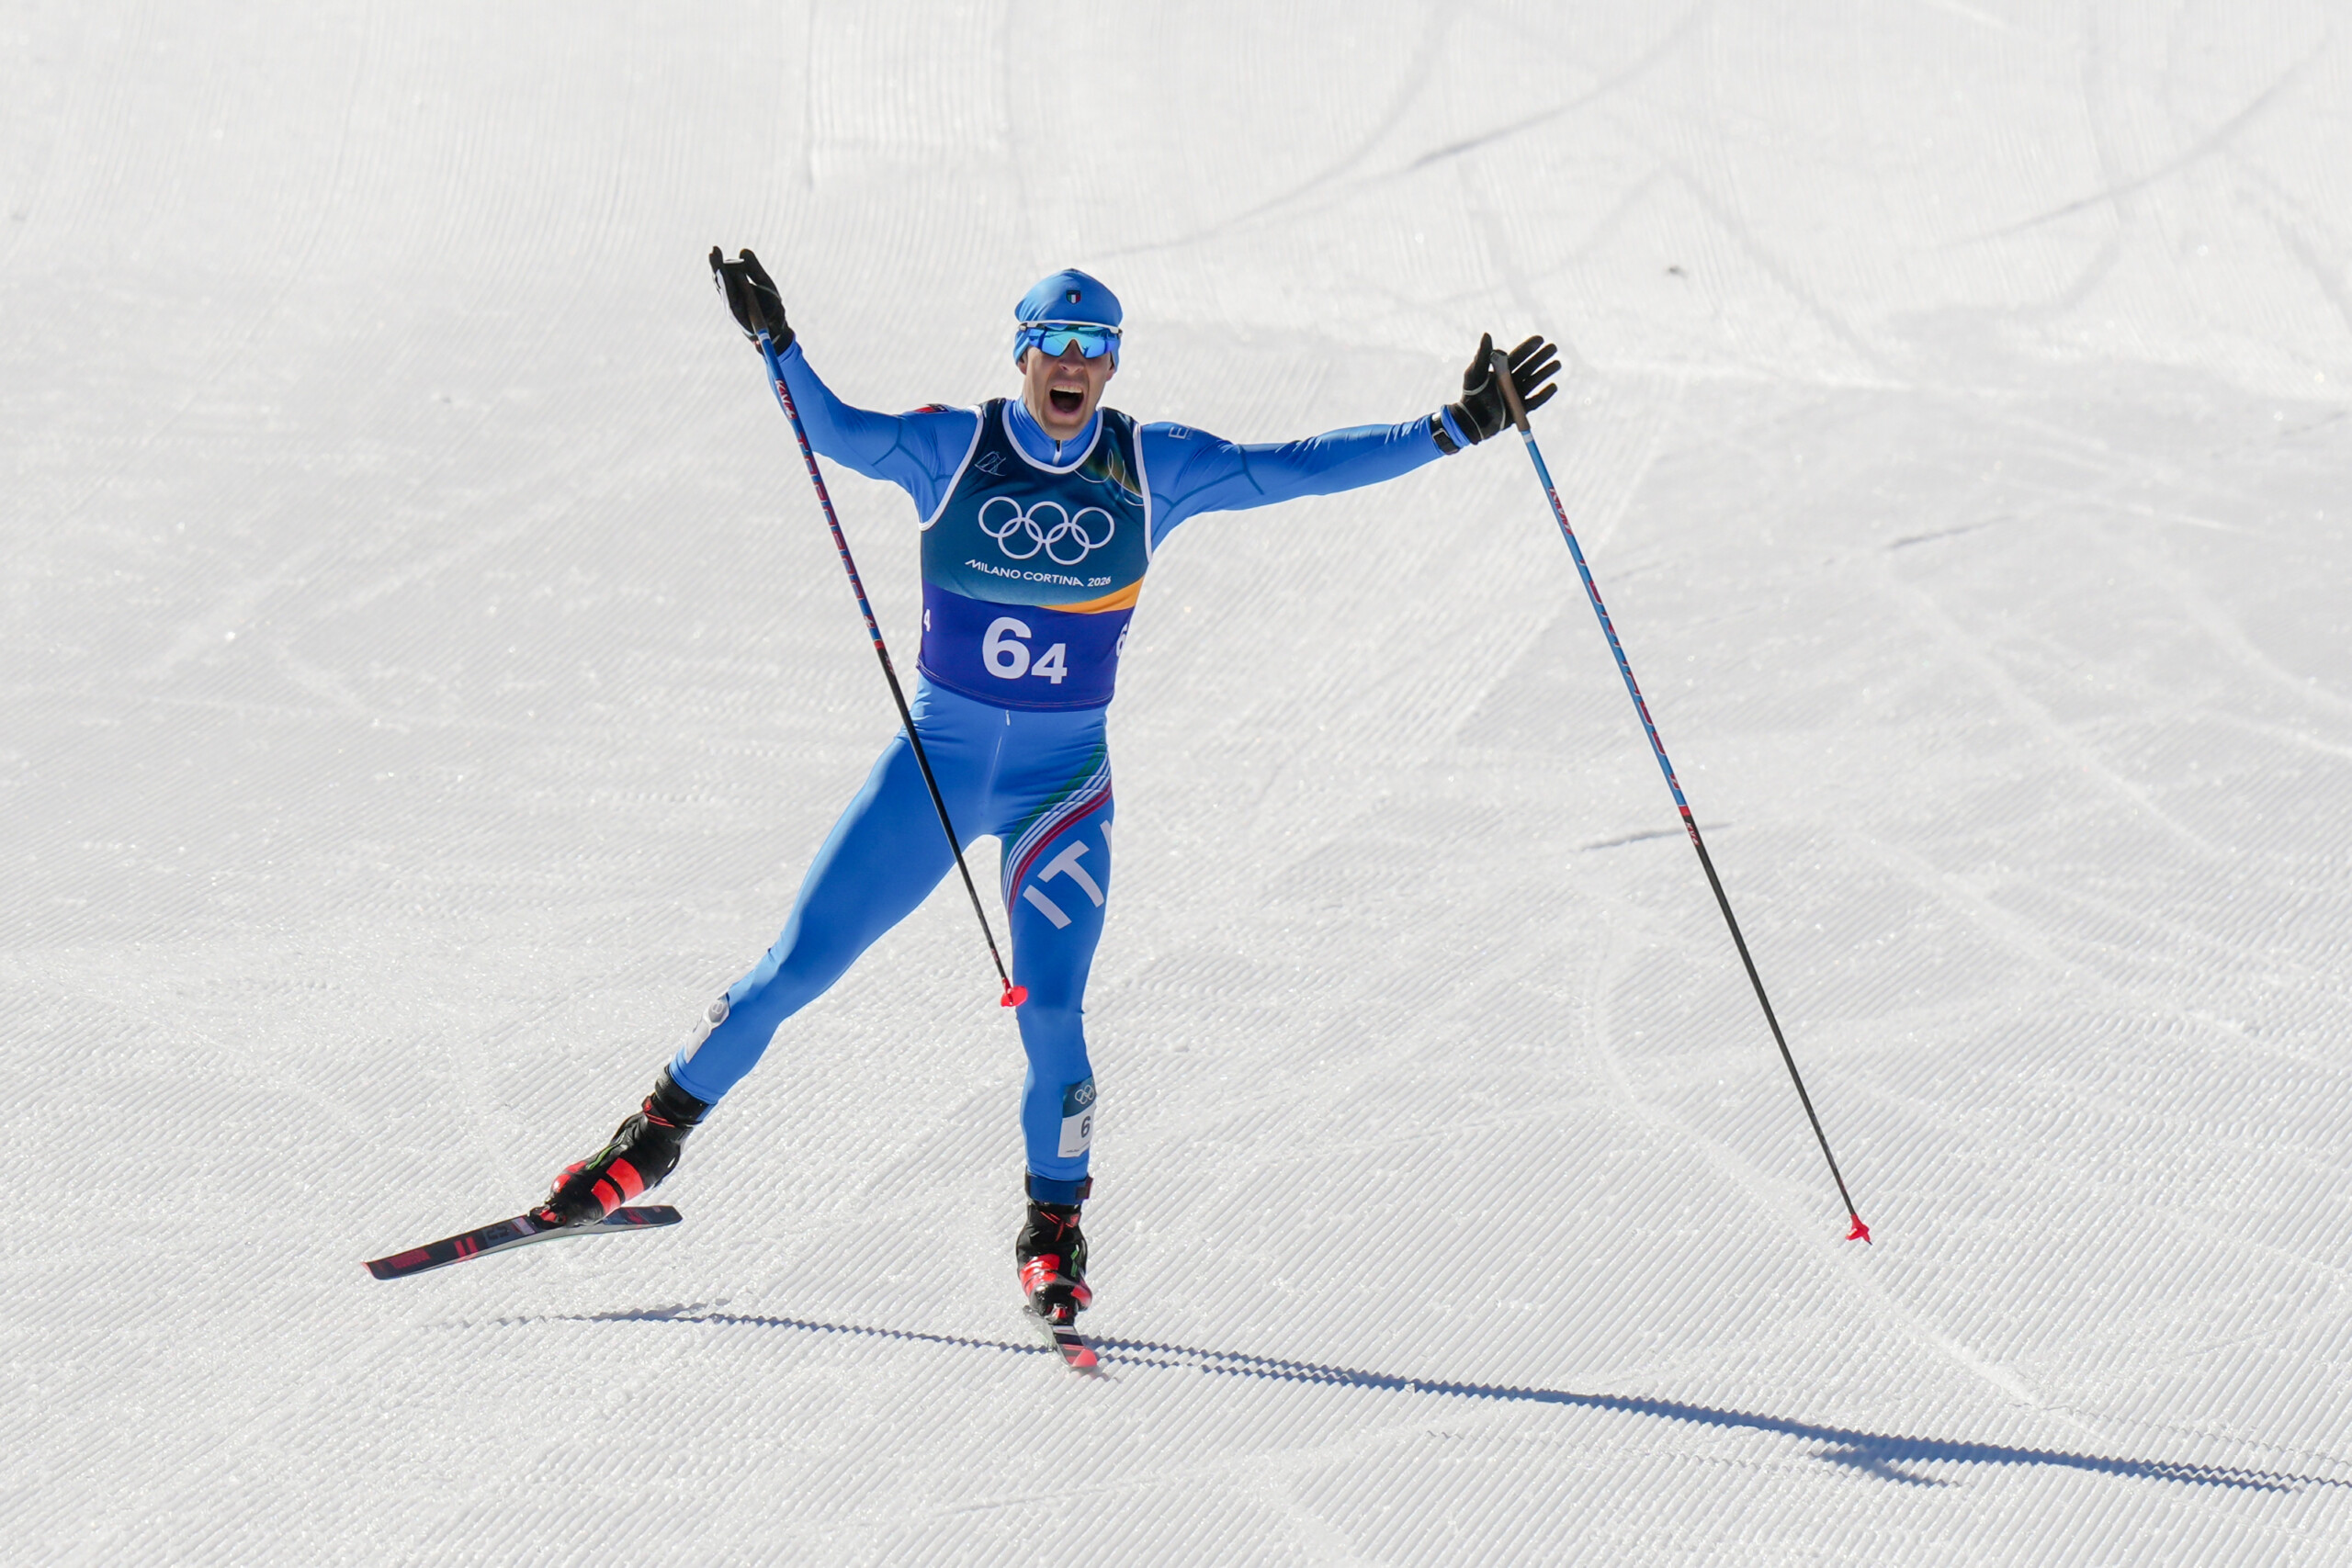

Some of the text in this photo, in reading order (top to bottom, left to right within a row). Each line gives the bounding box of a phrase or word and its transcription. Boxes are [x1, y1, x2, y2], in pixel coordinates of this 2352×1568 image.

[965, 558, 1112, 587] MILANO CORTINA 2026
[1081, 1115, 1091, 1138] 6
